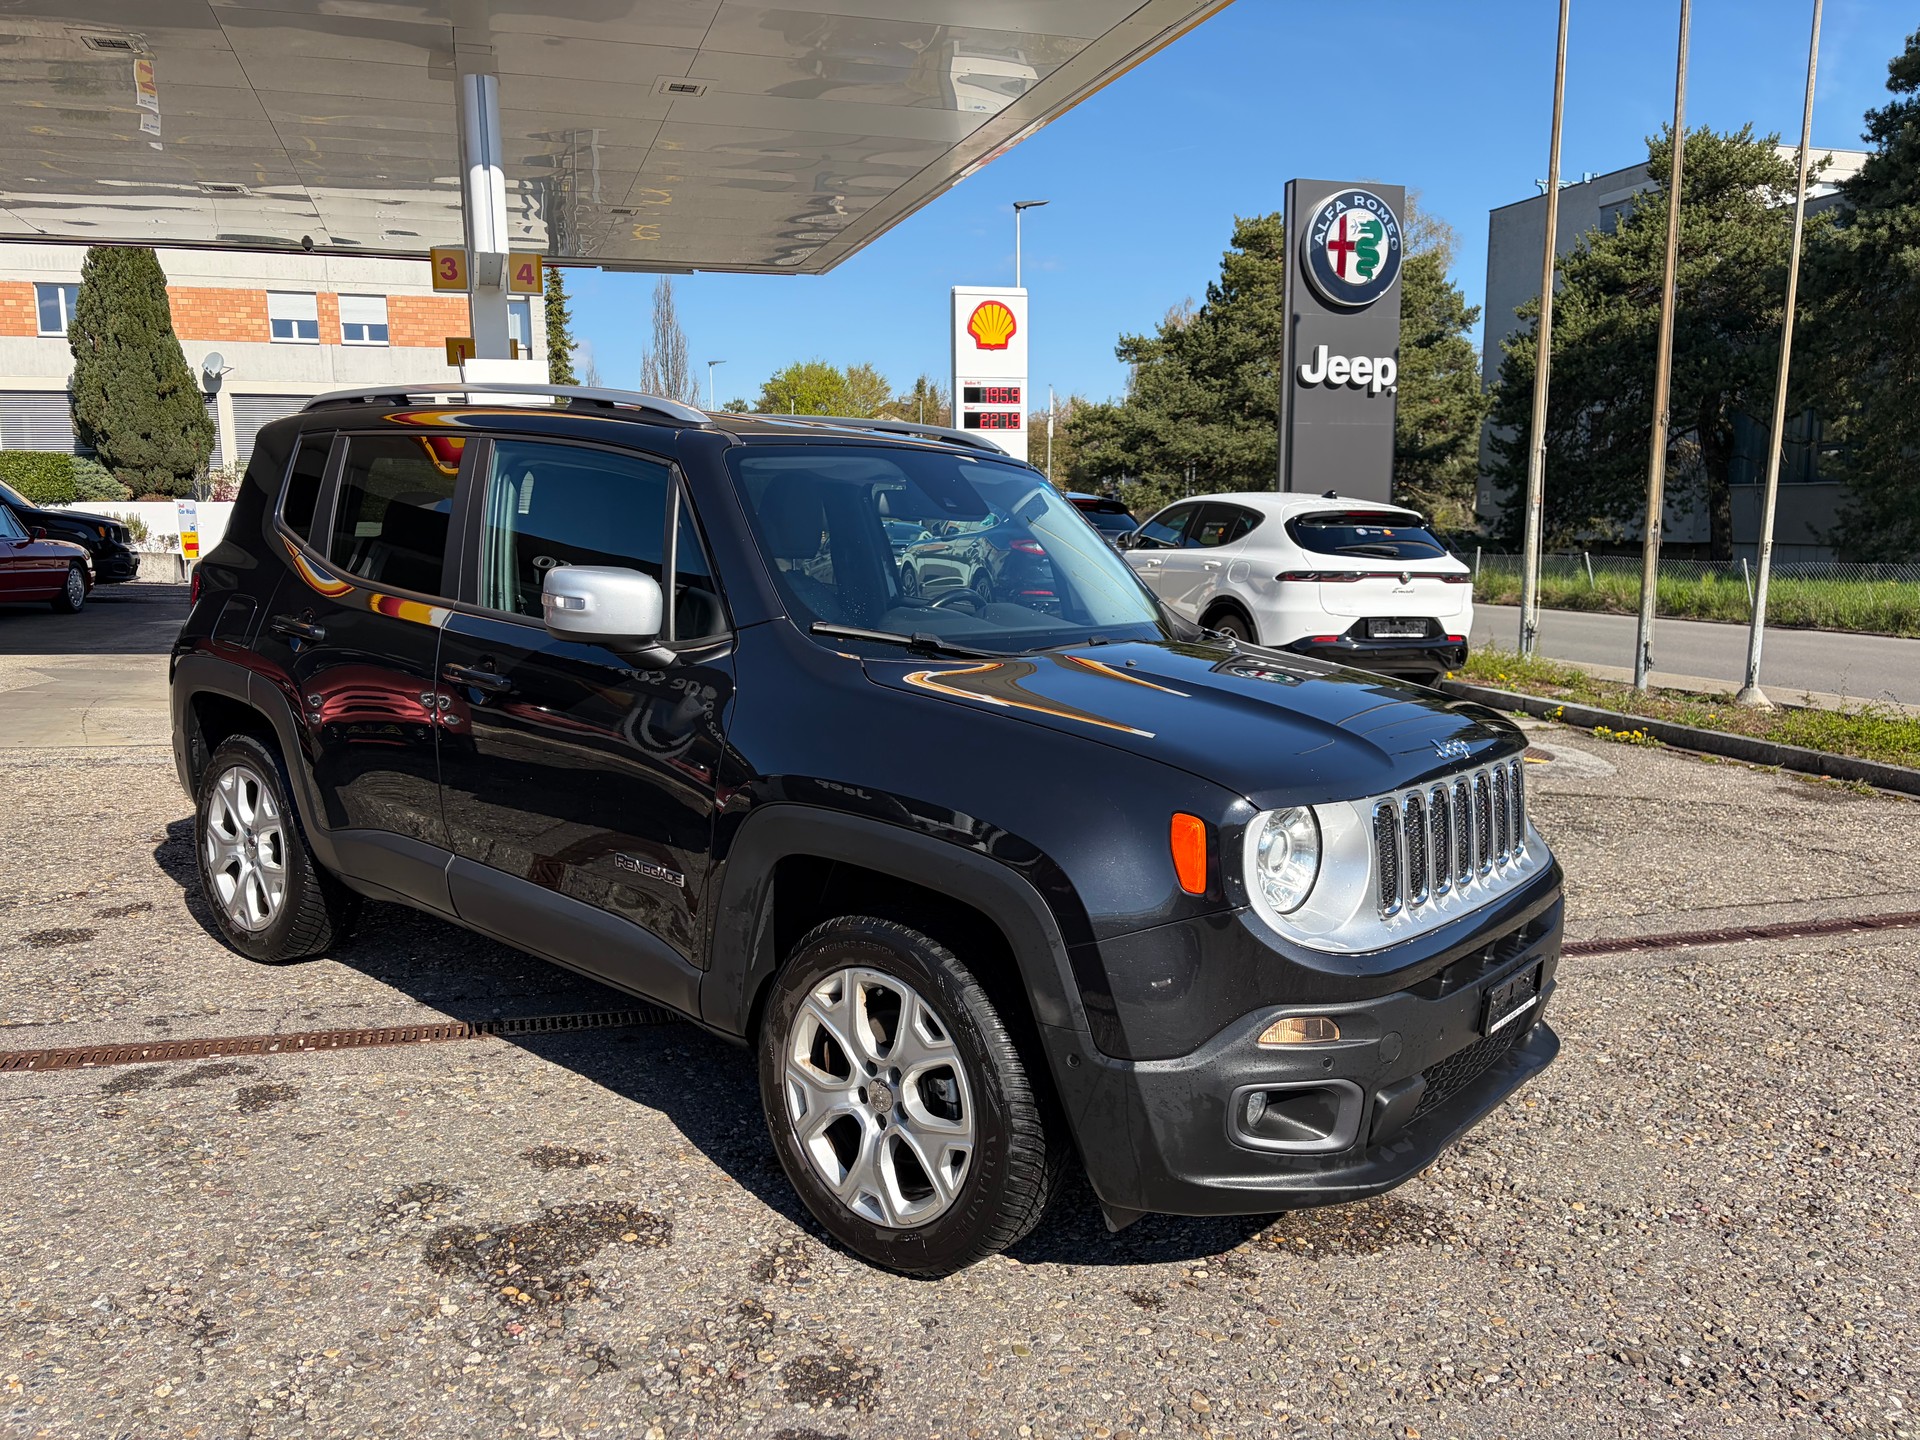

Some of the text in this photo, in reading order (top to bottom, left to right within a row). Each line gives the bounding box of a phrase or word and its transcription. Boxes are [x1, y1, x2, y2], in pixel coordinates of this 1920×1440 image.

[1314, 195, 1398, 250] ALFA ROMEO
[440, 257, 458, 281] 3
[516, 263, 535, 285] 4
[1301, 344, 1397, 393] Jeep
[985, 387, 1020, 404] 195.9
[980, 412, 1020, 429] 227.9
[615, 852, 685, 888] RENEGADE
